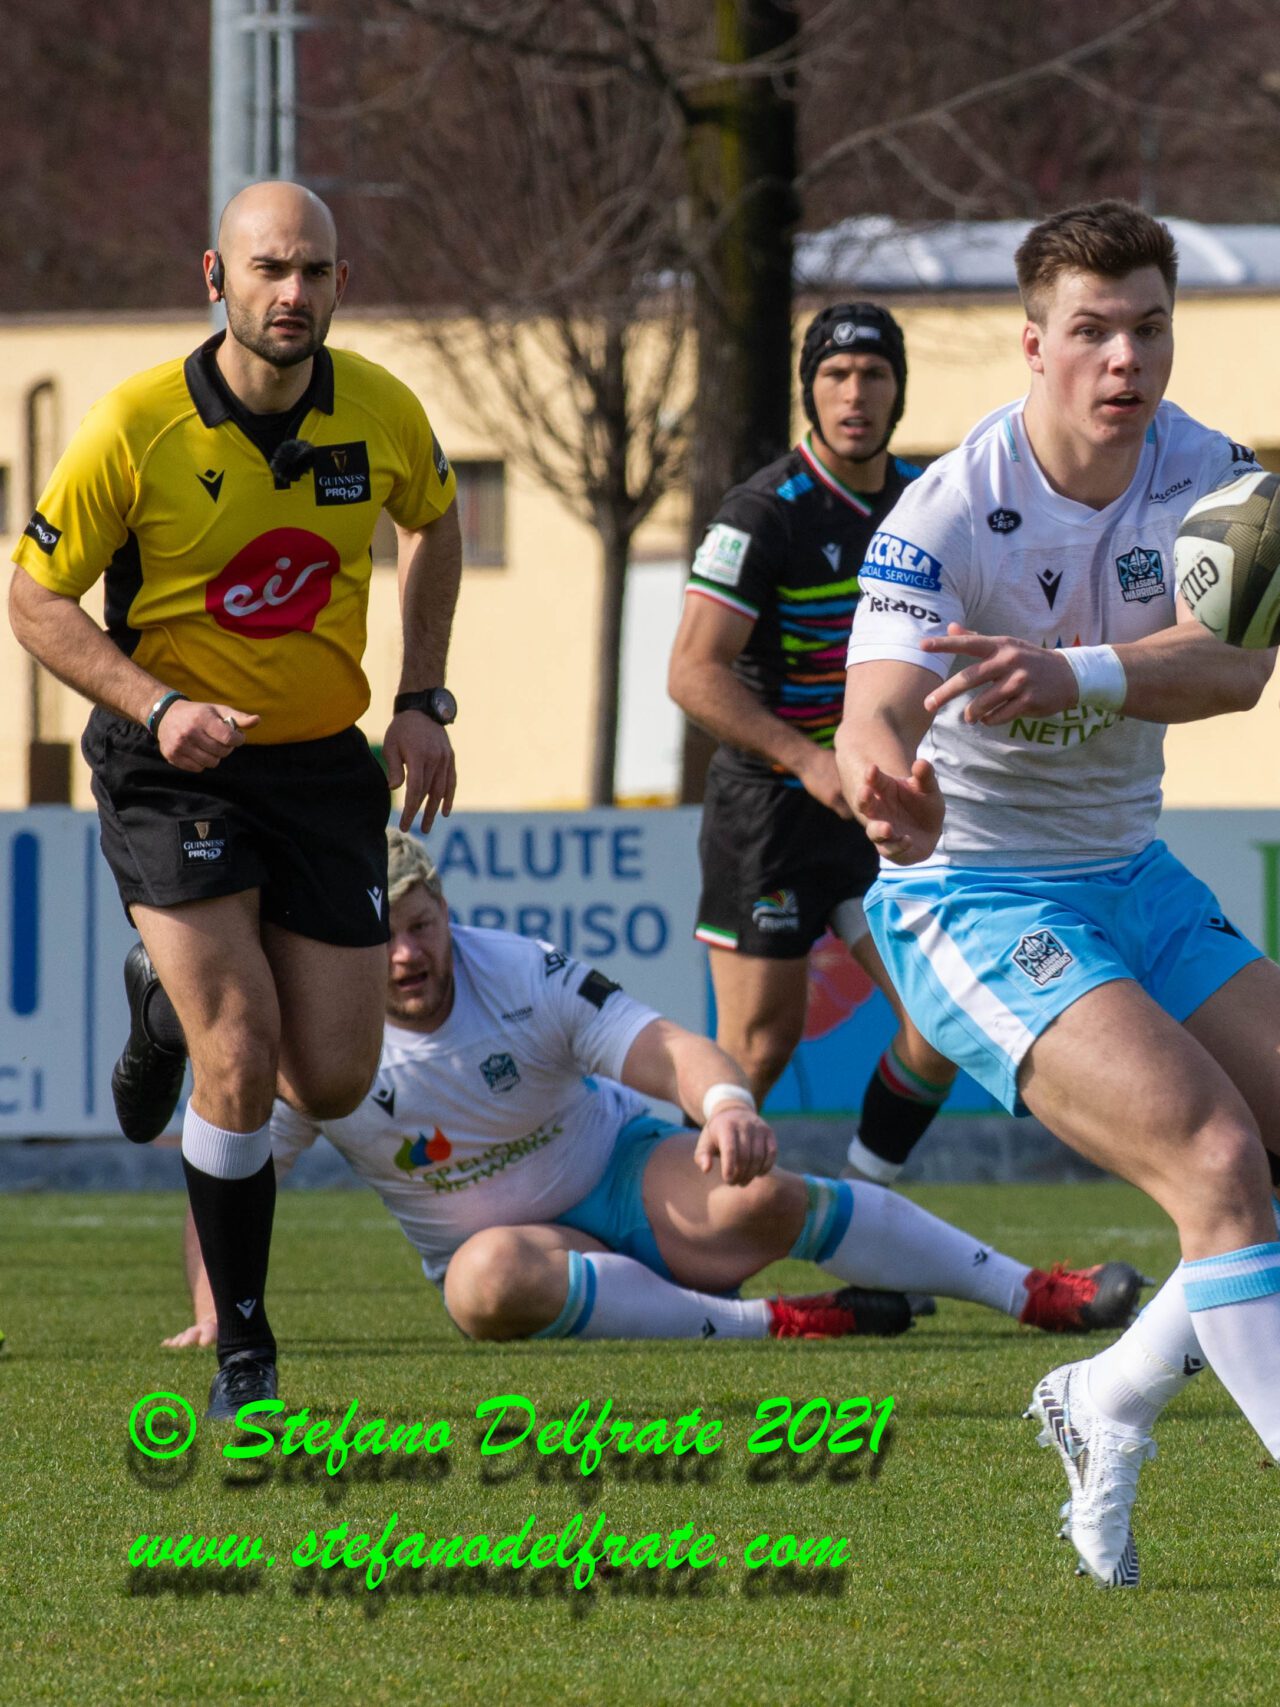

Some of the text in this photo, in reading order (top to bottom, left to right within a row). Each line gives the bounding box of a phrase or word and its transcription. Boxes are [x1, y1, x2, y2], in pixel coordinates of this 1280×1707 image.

[319, 474, 366, 488] GUINNESS
[885, 568, 937, 589] SERVICES
[183, 840, 226, 850] GUINNESS
[408, 826, 645, 881] ALUTE
